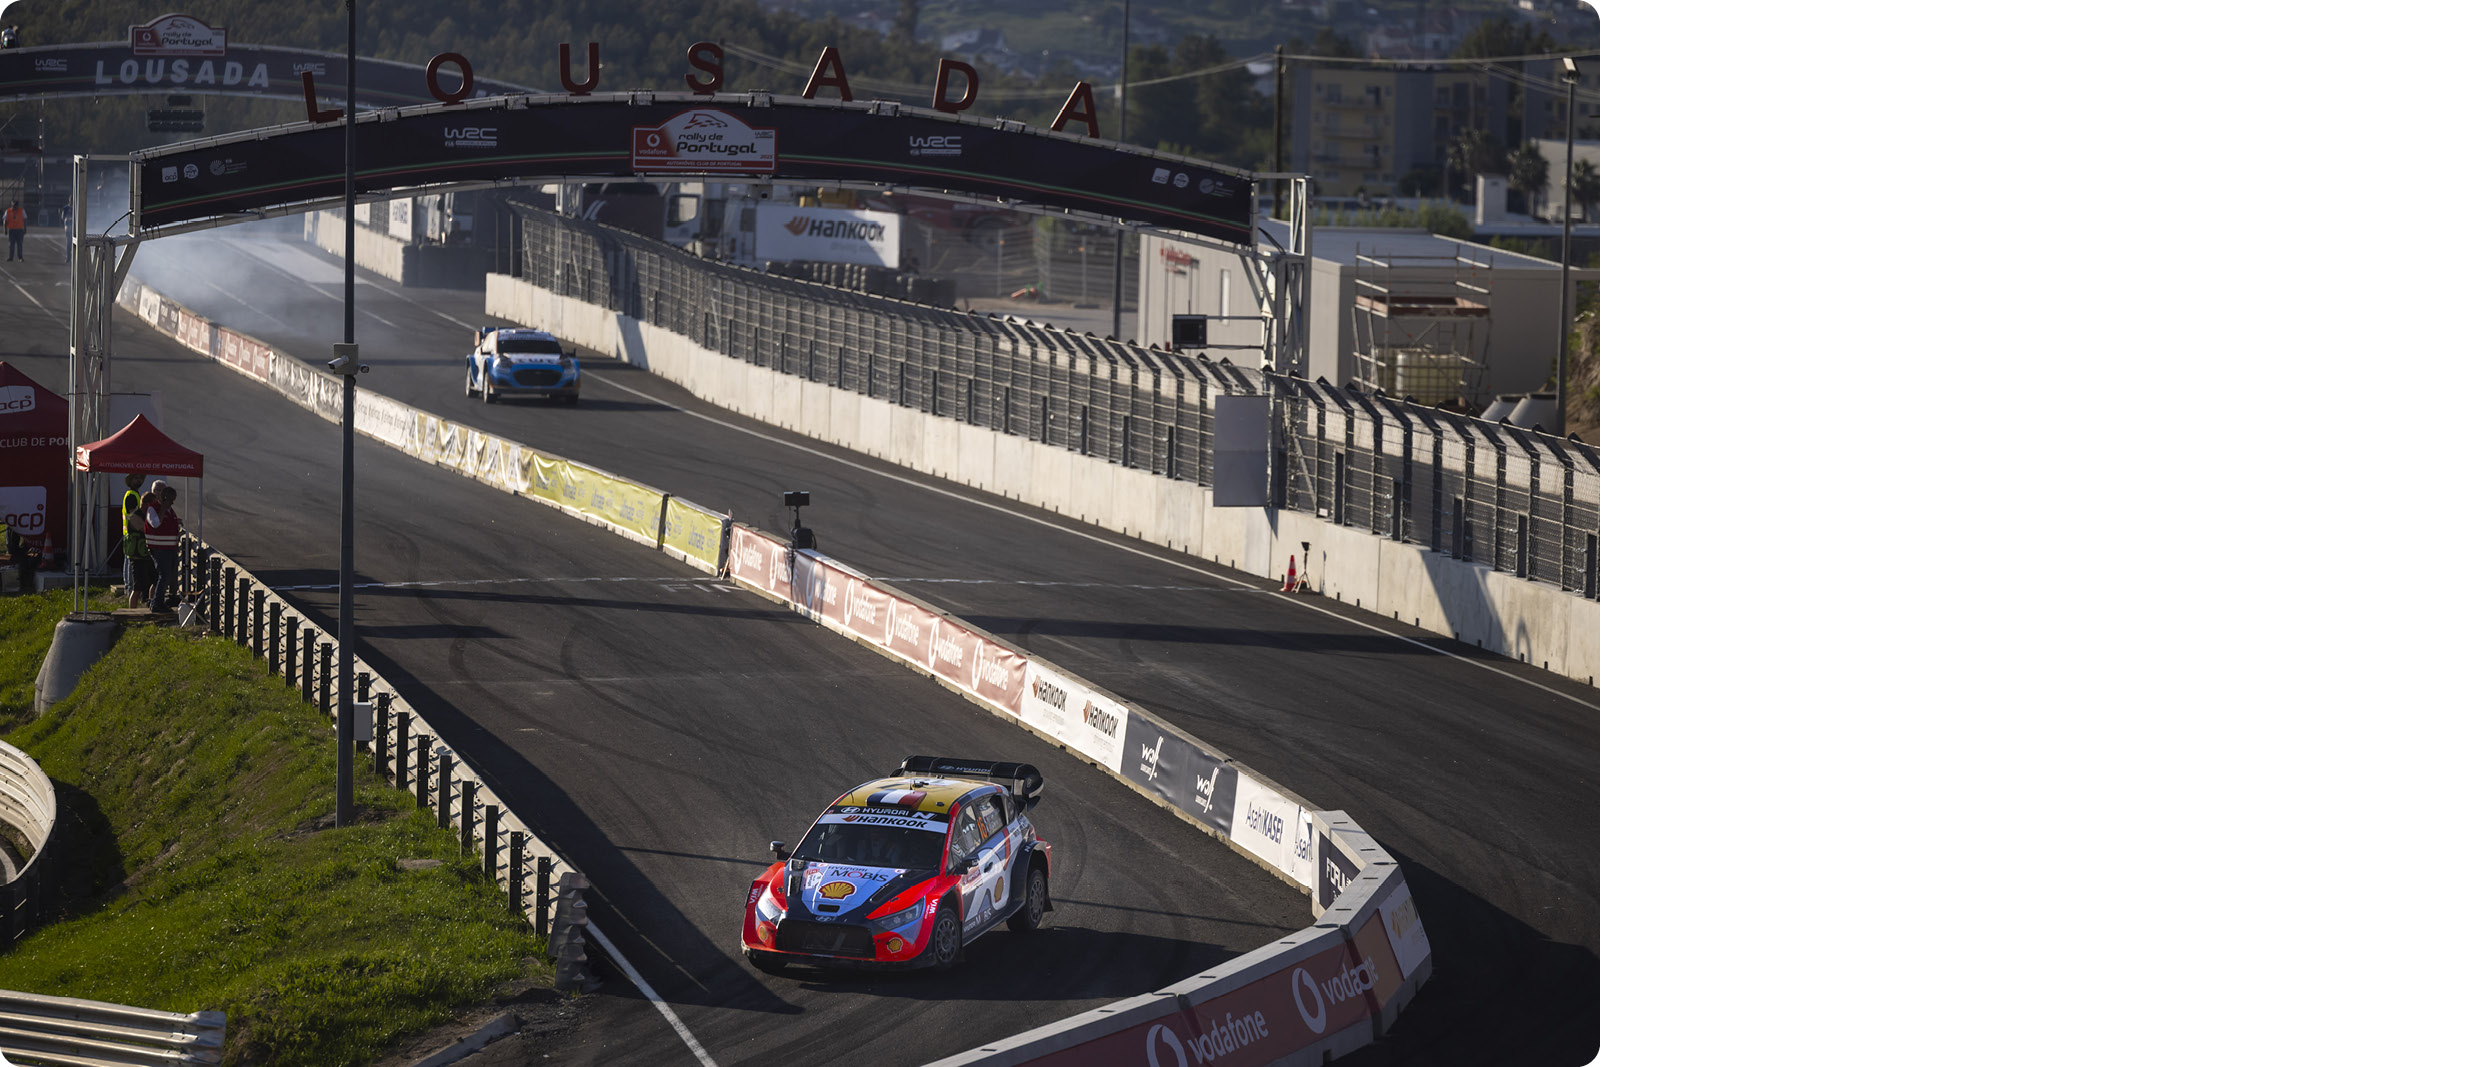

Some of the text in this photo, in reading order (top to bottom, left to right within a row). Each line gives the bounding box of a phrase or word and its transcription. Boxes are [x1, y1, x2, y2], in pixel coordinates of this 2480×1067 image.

[161, 38, 213, 47] Portugal
[95, 58, 269, 88] LOUSADA
[444, 127, 497, 139] WRC
[678, 133, 724, 142] rally de
[910, 136, 962, 147] WRC
[676, 142, 757, 155] Portugal
[31, 437, 45, 446] DE
[5, 513, 44, 530] acp
[742, 543, 763, 571] vodafone
[853, 593, 876, 624] vodafone
[895, 613, 919, 646] vodafone
[938, 635, 963, 668] vodafone
[982, 656, 1009, 691] vodafone
[862, 807, 937, 820] HYUNDAI N
[977, 816, 987, 840] 16
[830, 869, 889, 882] MOBIS
[1187, 1010, 1269, 1064] vodafone
